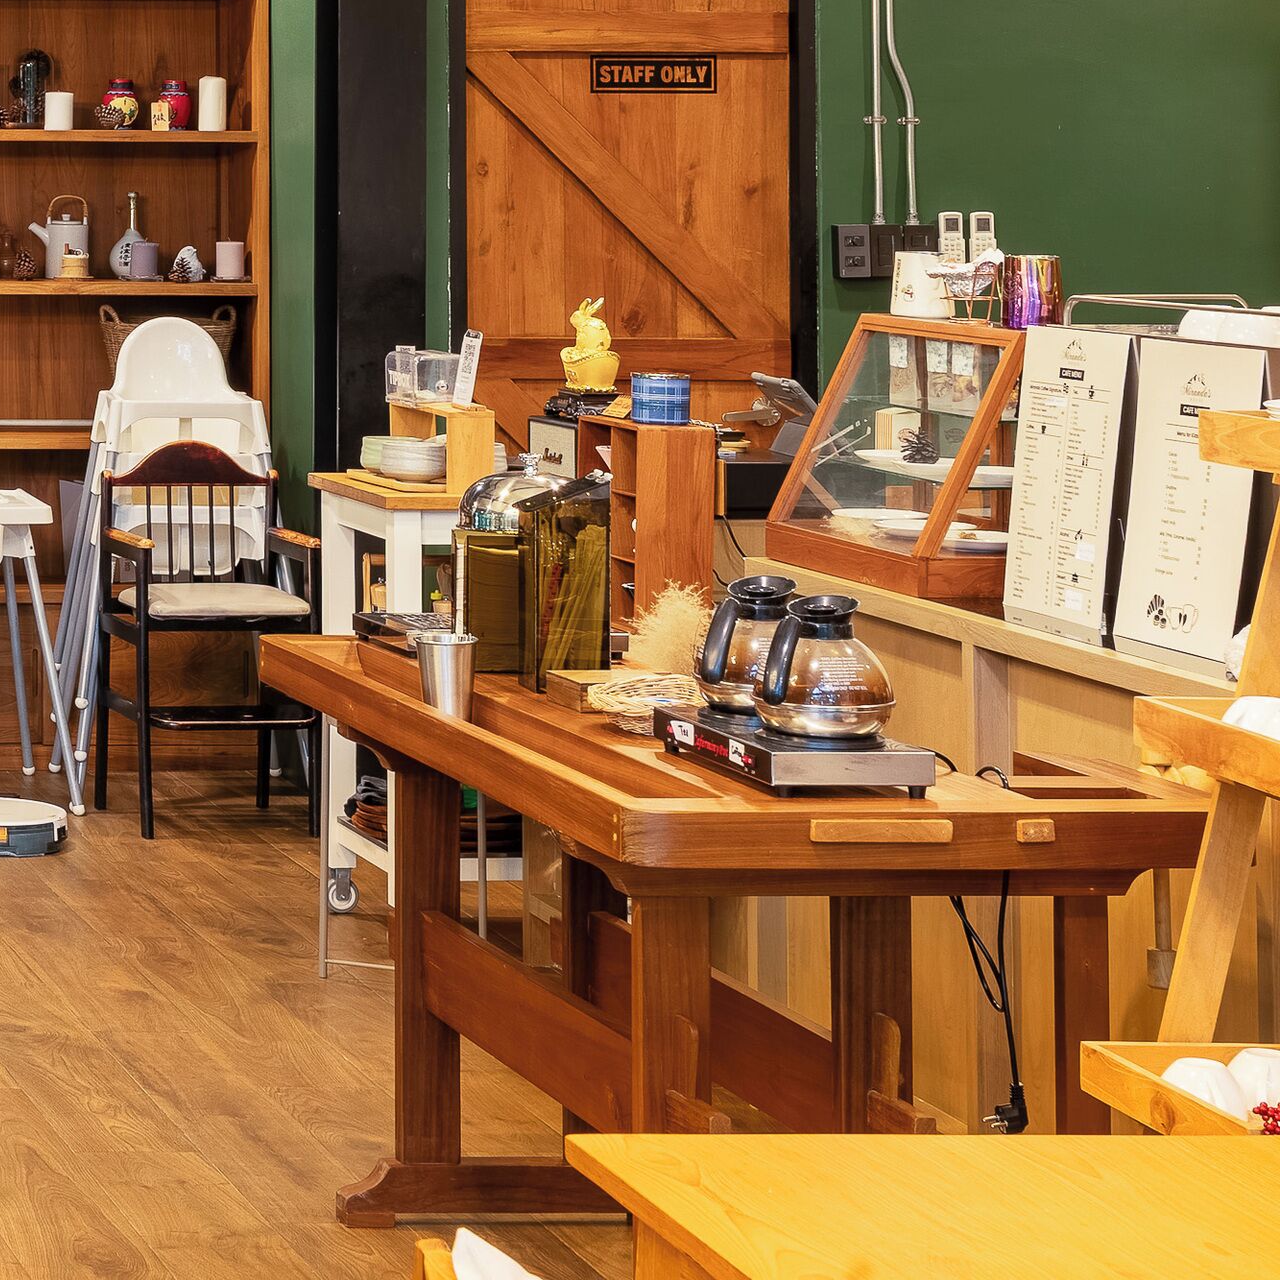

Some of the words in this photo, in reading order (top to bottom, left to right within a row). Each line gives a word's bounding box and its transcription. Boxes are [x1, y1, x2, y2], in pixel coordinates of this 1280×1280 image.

[599, 65, 655, 83] STAFF
[660, 65, 708, 83] ONLY
[1061, 369, 1071, 377] CAFE
